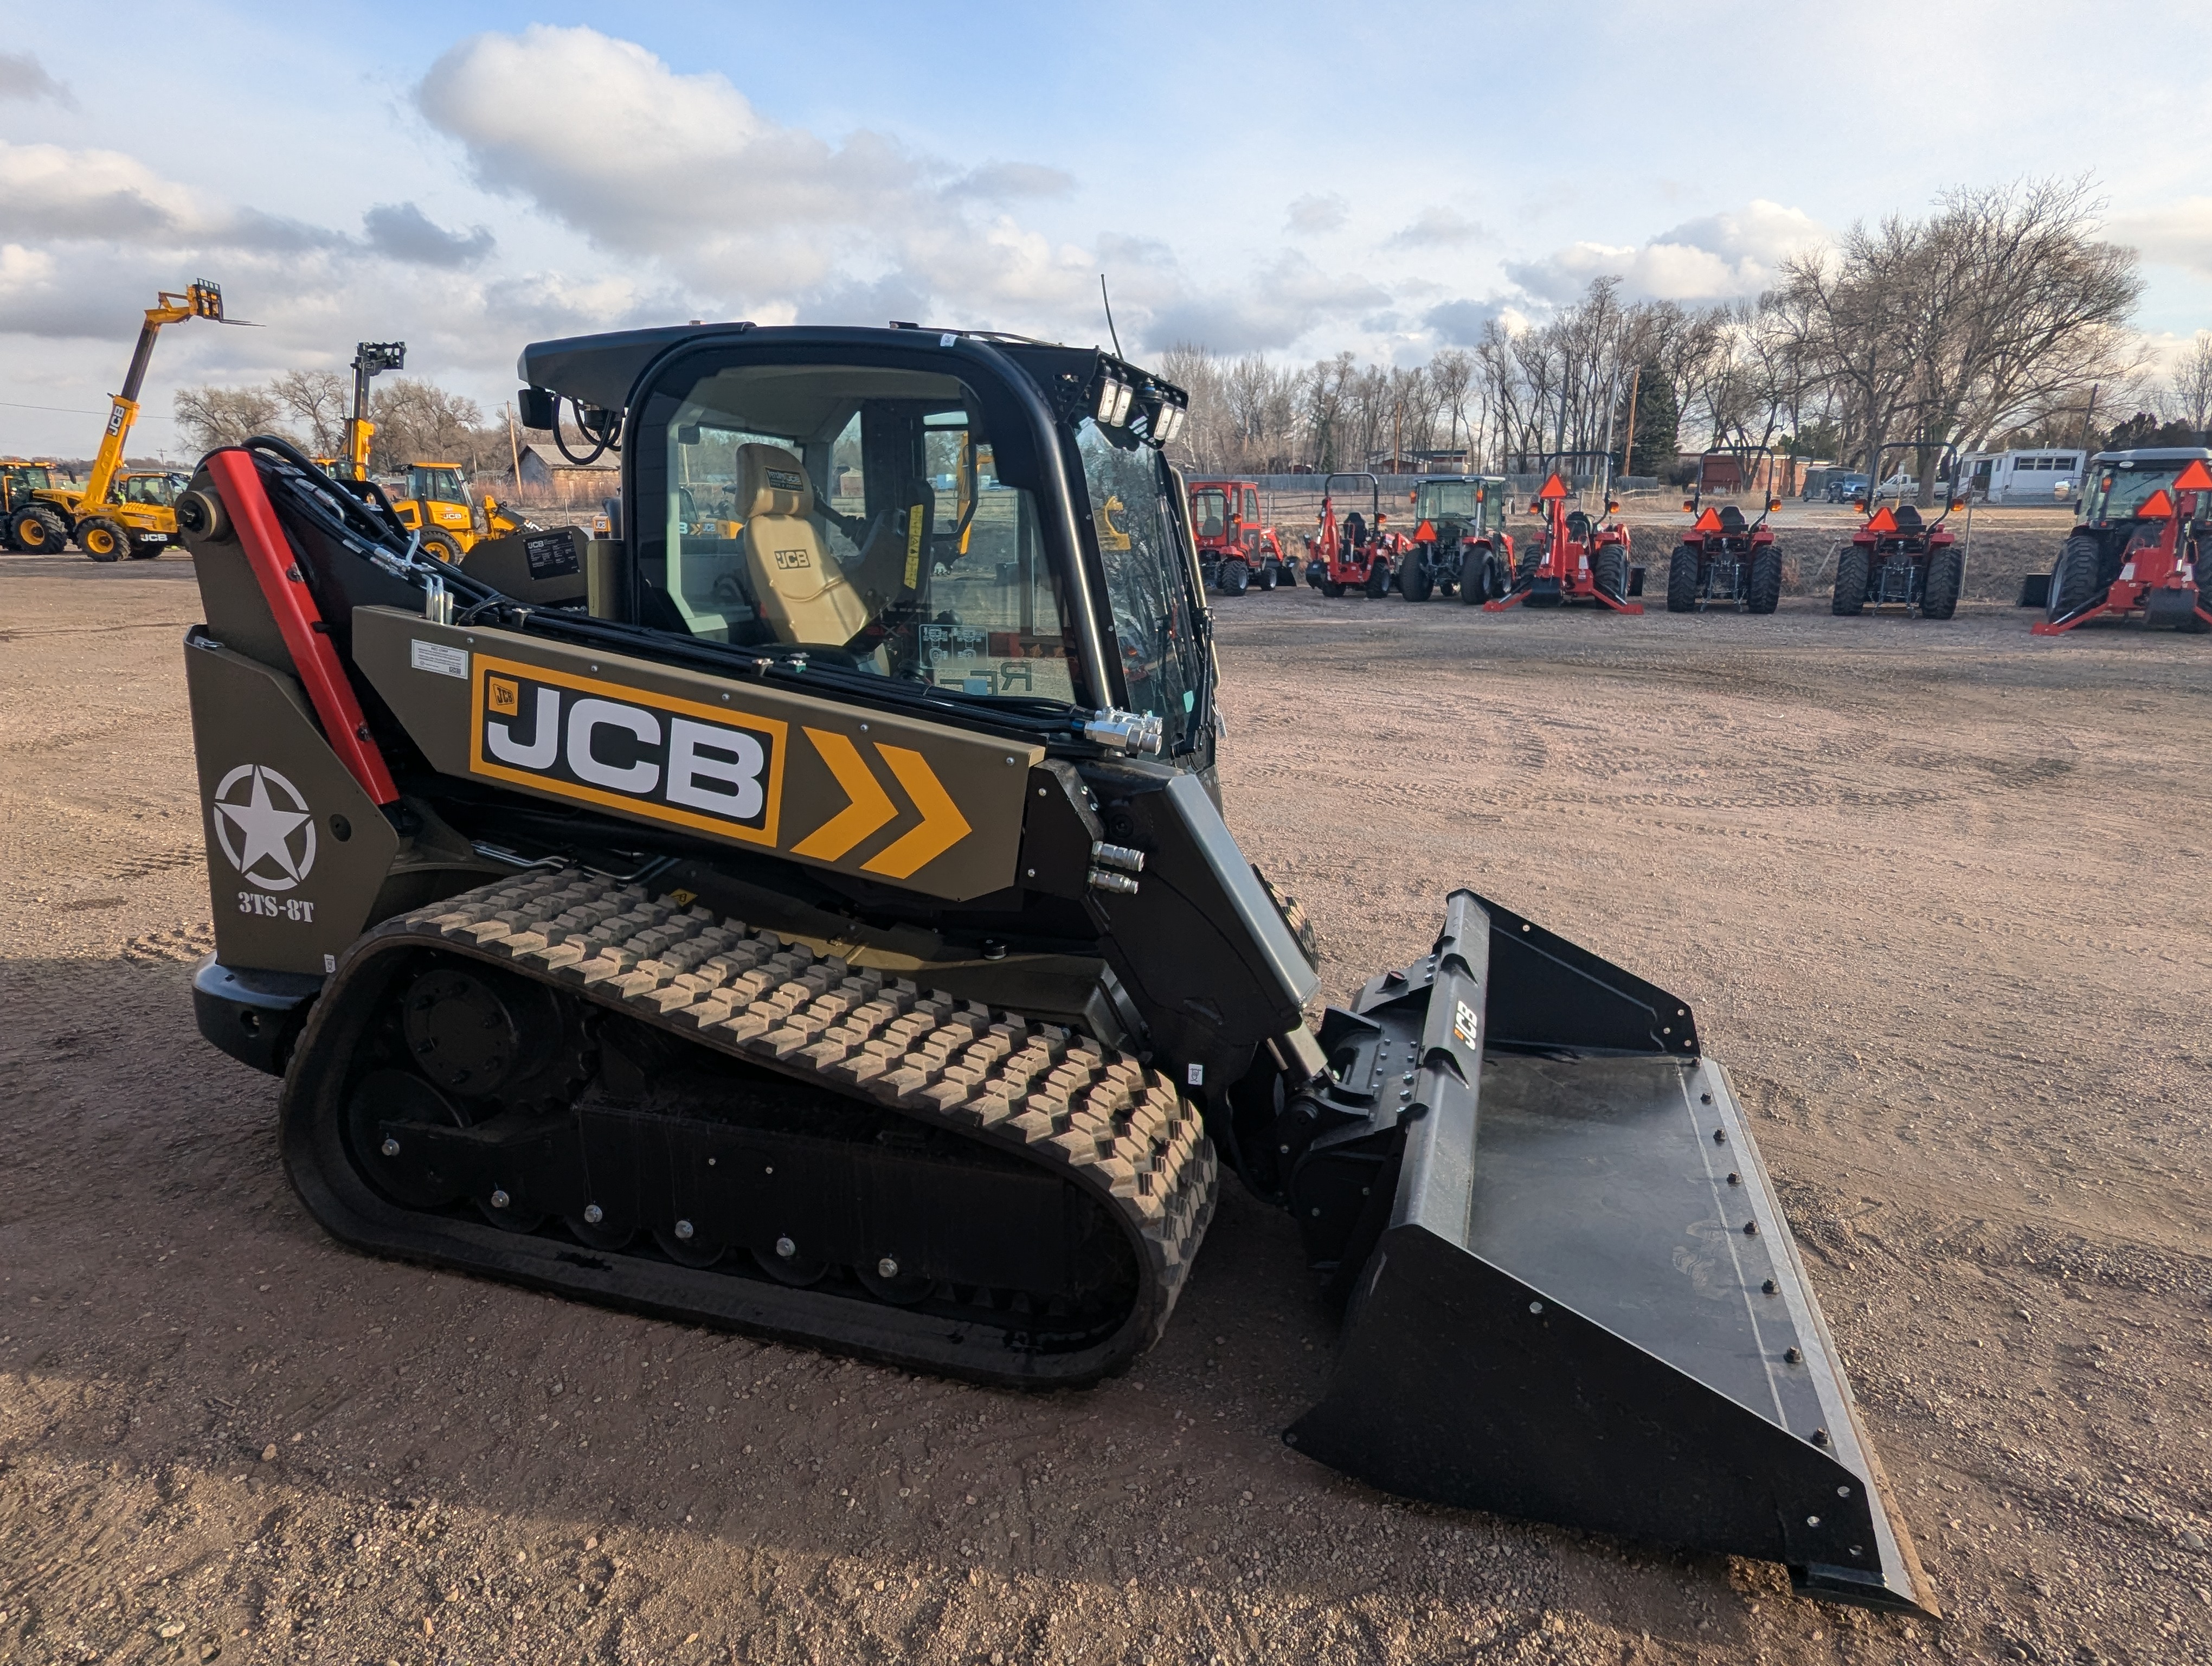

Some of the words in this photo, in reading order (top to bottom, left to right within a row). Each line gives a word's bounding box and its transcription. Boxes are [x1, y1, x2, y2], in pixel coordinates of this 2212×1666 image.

[109, 405, 125, 436] JCB
[141, 534, 168, 542] JCB
[775, 551, 809, 568] JCB
[497, 687, 513, 703] JCB
[488, 687, 764, 819] JCB
[238, 892, 314, 922] 3TS-8T
[1455, 1000, 1477, 1050] JCB
